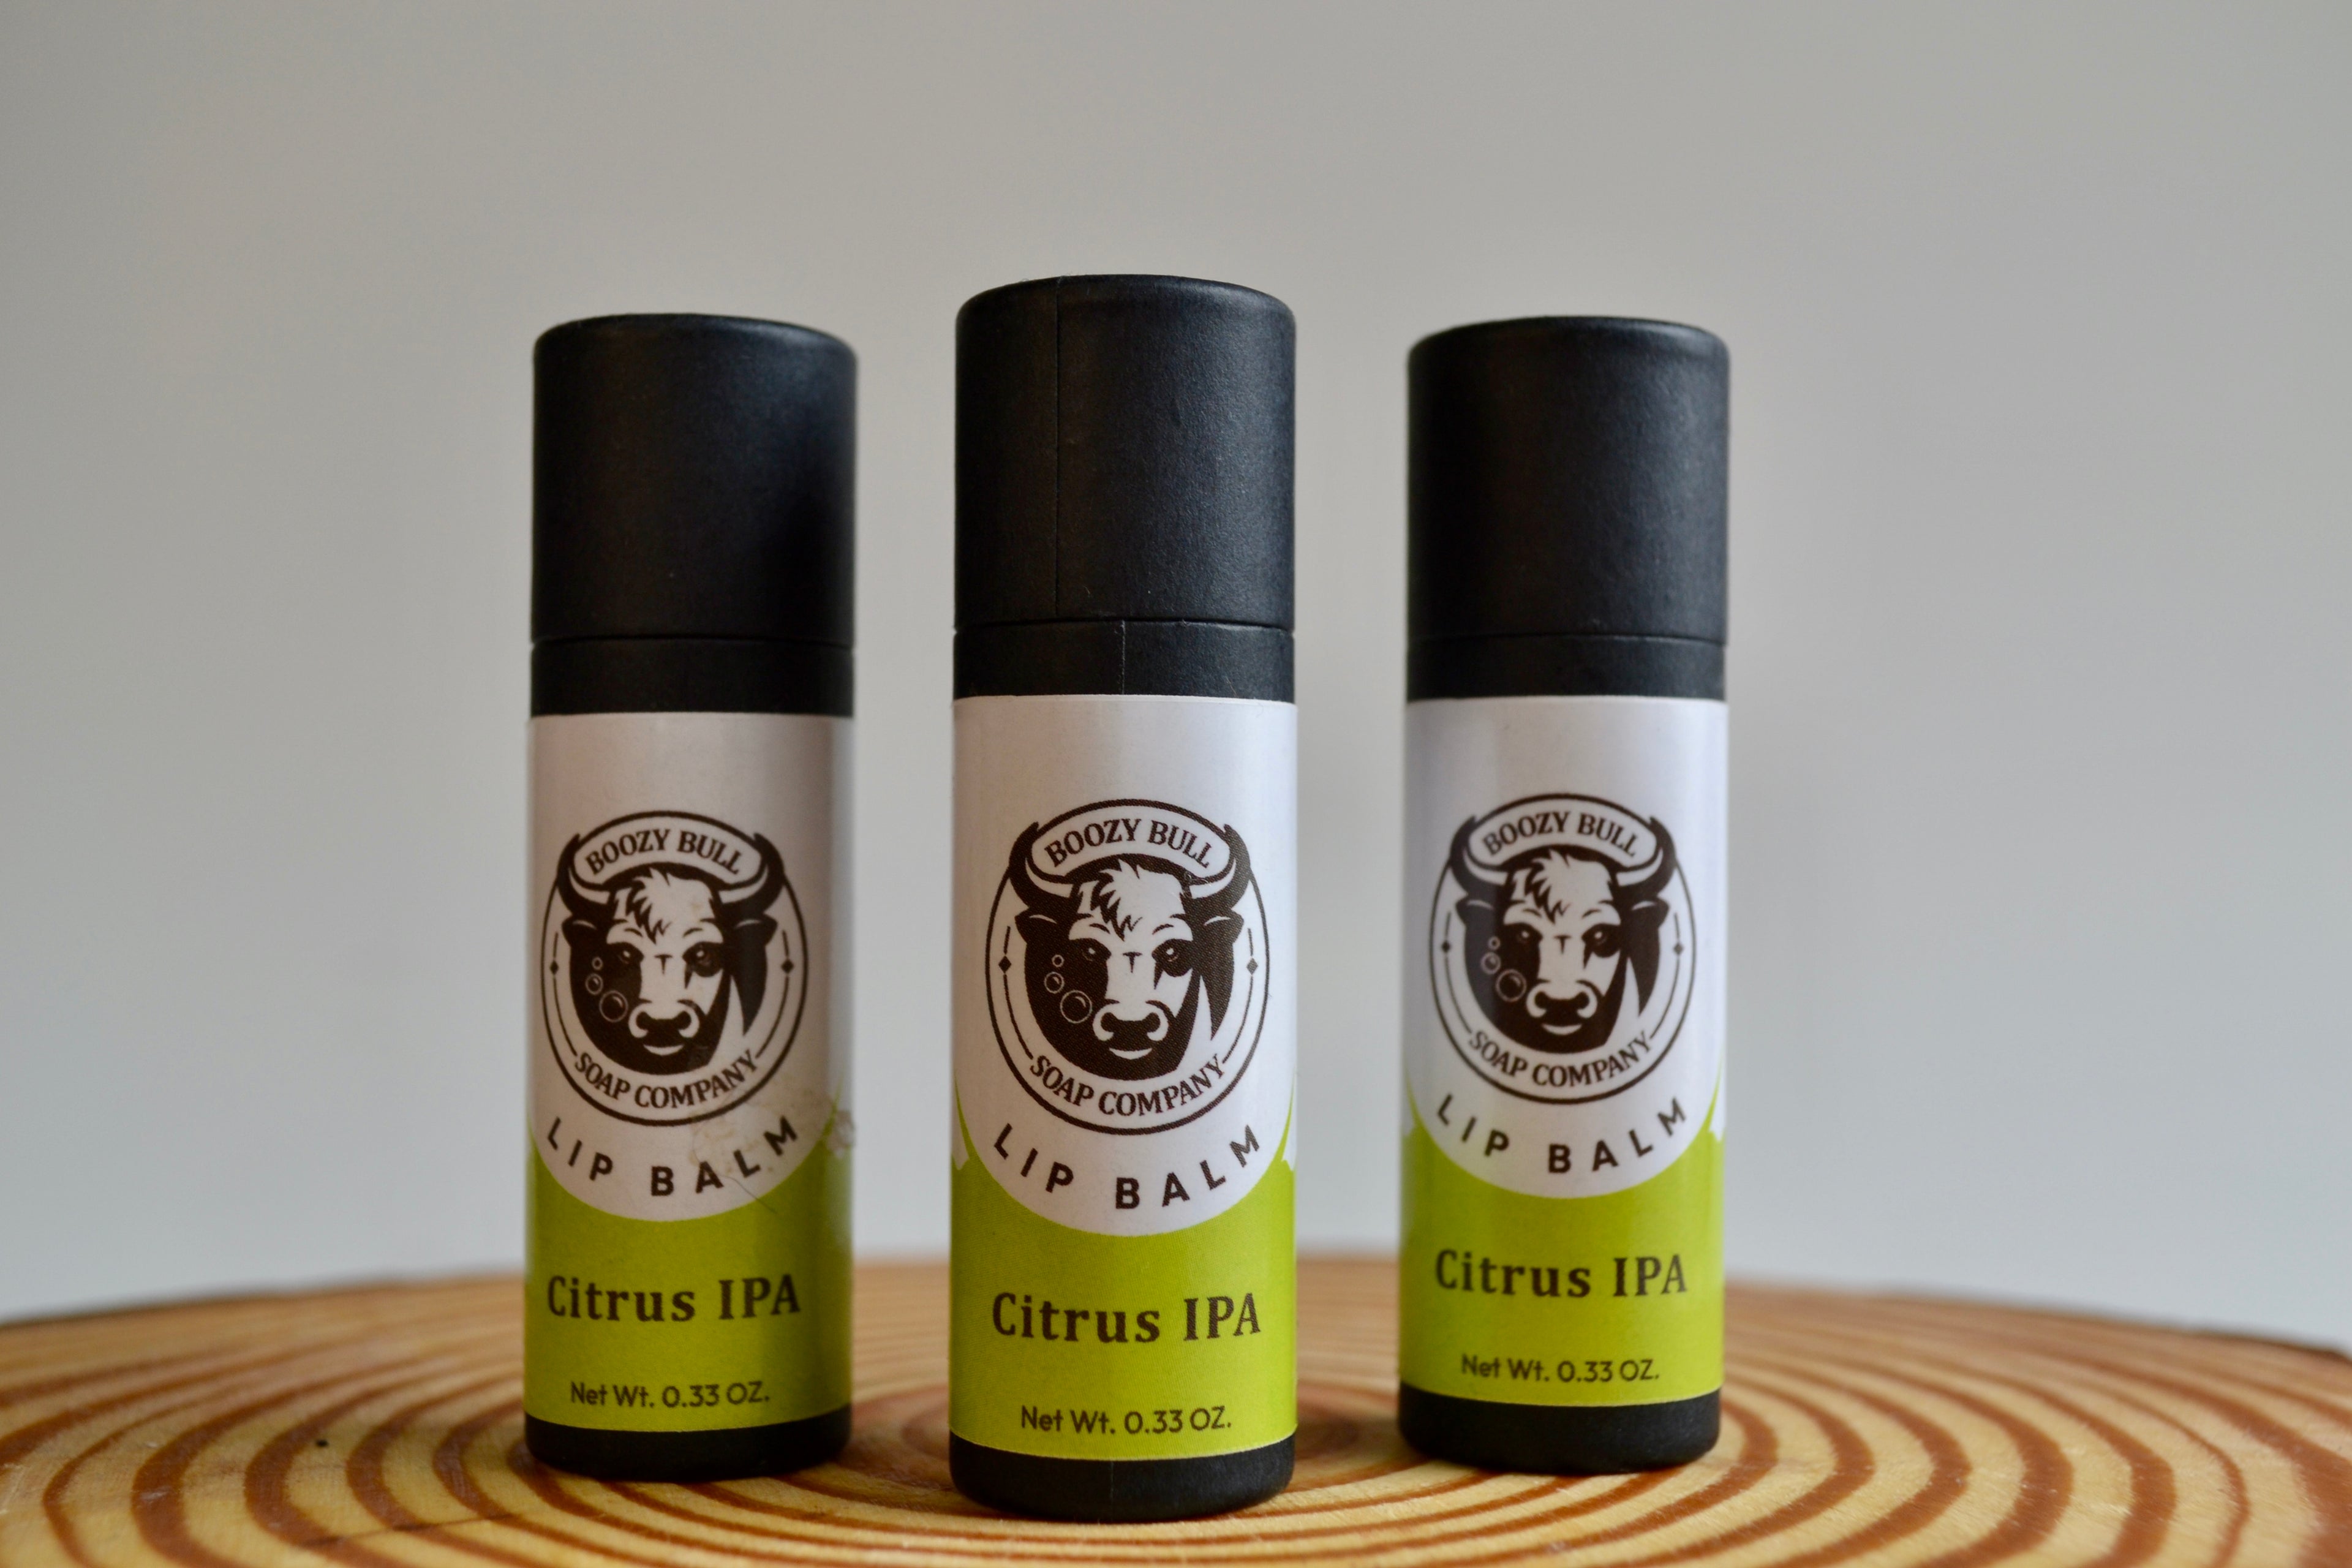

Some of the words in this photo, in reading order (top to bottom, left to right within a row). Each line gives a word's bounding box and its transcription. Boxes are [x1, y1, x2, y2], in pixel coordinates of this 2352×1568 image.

[585, 829, 671, 875] BOOZY
[677, 831, 742, 873] BULL
[1044, 819, 1141, 867] BOOZY
[1148, 820, 1213, 868] BULL
[1482, 812, 1571, 856] BOOZY
[1577, 813, 1640, 857] BULL
[575, 1052, 631, 1100] SOAP
[635, 1049, 759, 1108] COMPANY
[1470, 1030, 1528, 1077] SOAP
[1532, 1031, 1651, 1087] COMPANY
[1030, 1055, 1094, 1107] SOAP
[1099, 1054, 1224, 1116] COMPANY
[547, 1117, 612, 1181] LIP
[651, 1116, 797, 1196] BALM
[1437, 1094, 1509, 1157] LIP
[1548, 1098, 1686, 1173] BALM
[993, 1123, 1074, 1193] LIP
[1116, 1125, 1259, 1209] BALM
[547, 1276, 695, 1322] Citrus
[718, 1274, 801, 1319] IPA
[1436, 1250, 1591, 1297] Citrus
[1613, 1254, 1687, 1297] IPA
[993, 1292, 1159, 1343] Citrus
[1183, 1293, 1261, 1341] IPA
[1462, 1354, 1500, 1376] Net
[1507, 1359, 1549, 1382] Wt.
[1558, 1361, 1612, 1382] 0.33
[1620, 1359, 1659, 1381] OZ.
[571, 1382, 608, 1406] Net
[612, 1385, 654, 1408] Wt.
[662, 1384, 719, 1408] 0.33
[726, 1381, 770, 1402] OZ.
[1022, 1406, 1063, 1431] Net
[1070, 1411, 1115, 1434] Wt.
[1125, 1411, 1182, 1434] 0.33
[1190, 1406, 1231, 1430] OZ.
